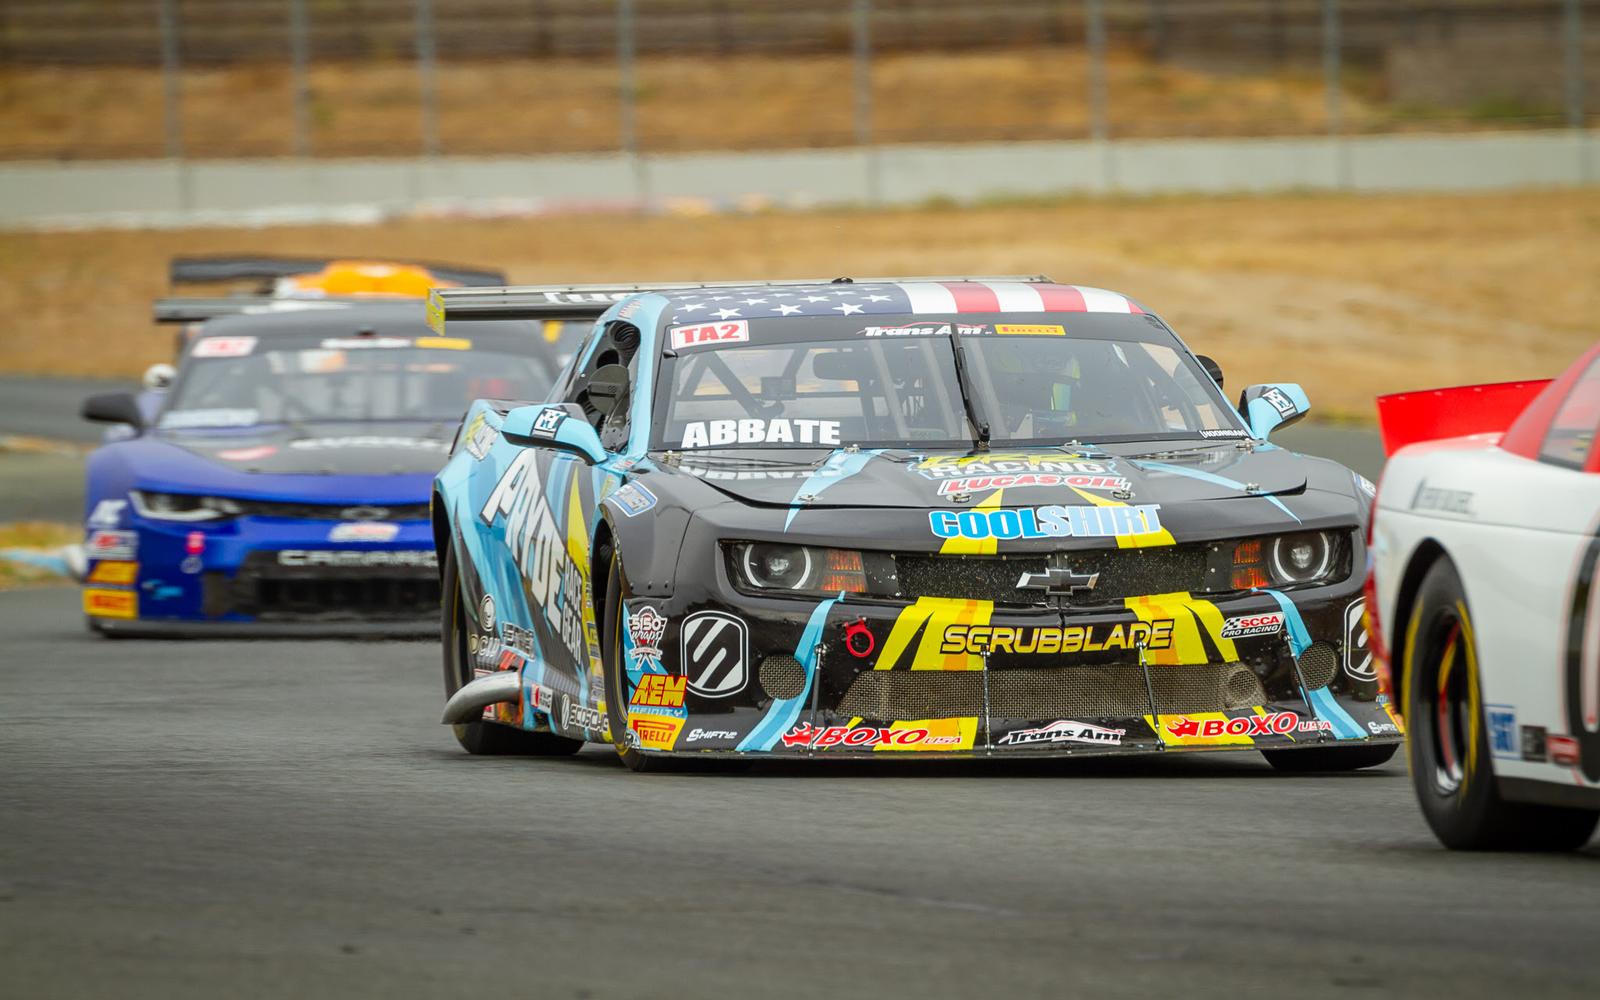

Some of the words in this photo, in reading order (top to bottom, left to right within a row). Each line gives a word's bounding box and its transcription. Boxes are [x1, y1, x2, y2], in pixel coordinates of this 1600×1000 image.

[680, 324, 740, 344] TA2
[864, 326, 934, 337] Trans
[681, 418, 841, 449] ABBATE
[929, 461, 1106, 477] RACING
[945, 474, 1058, 492] LUCAS
[1065, 475, 1124, 488] OIL
[929, 504, 1161, 540] COOLSHIRT
[1223, 629, 1242, 638] PRO
[1243, 625, 1279, 636] RACING
[1240, 615, 1280, 628] SCCA
[561, 601, 584, 668] GEAR
[941, 619, 1174, 654] SCRUBBLADE
[630, 673, 688, 708] AEM
[632, 720, 676, 743] PIRELLI
[1202, 711, 1299, 737] BOXO
[1298, 720, 1332, 732] USA
[814, 726, 928, 746] BOXO
[925, 736, 961, 745] USA
[1008, 729, 1074, 742] Trans
[1077, 728, 1120, 741] Am
